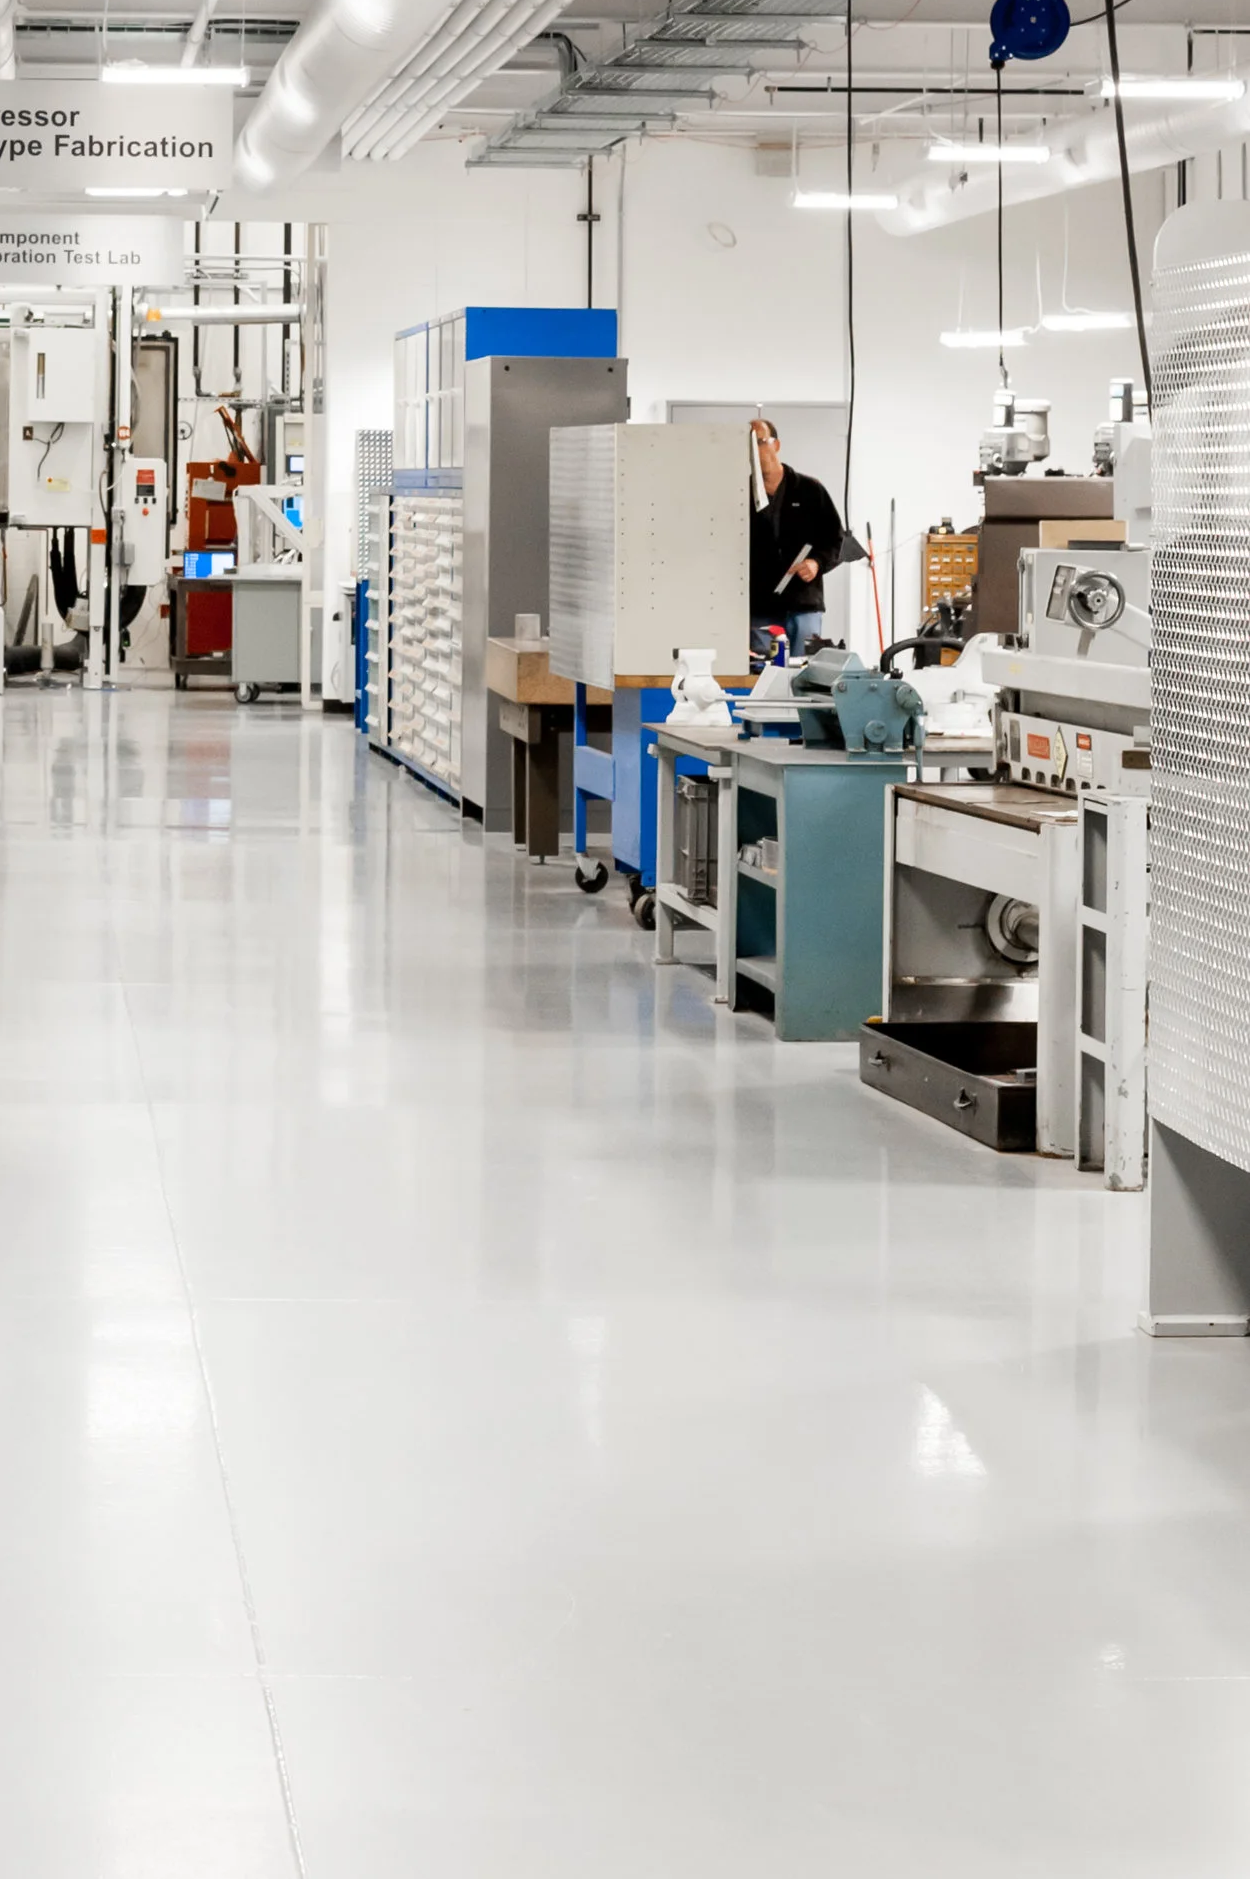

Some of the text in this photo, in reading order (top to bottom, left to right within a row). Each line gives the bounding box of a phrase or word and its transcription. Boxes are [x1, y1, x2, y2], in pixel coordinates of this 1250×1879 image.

[53, 135, 214, 158] Fabrication
[64, 249, 101, 264] Test
[108, 250, 142, 264] Lab
